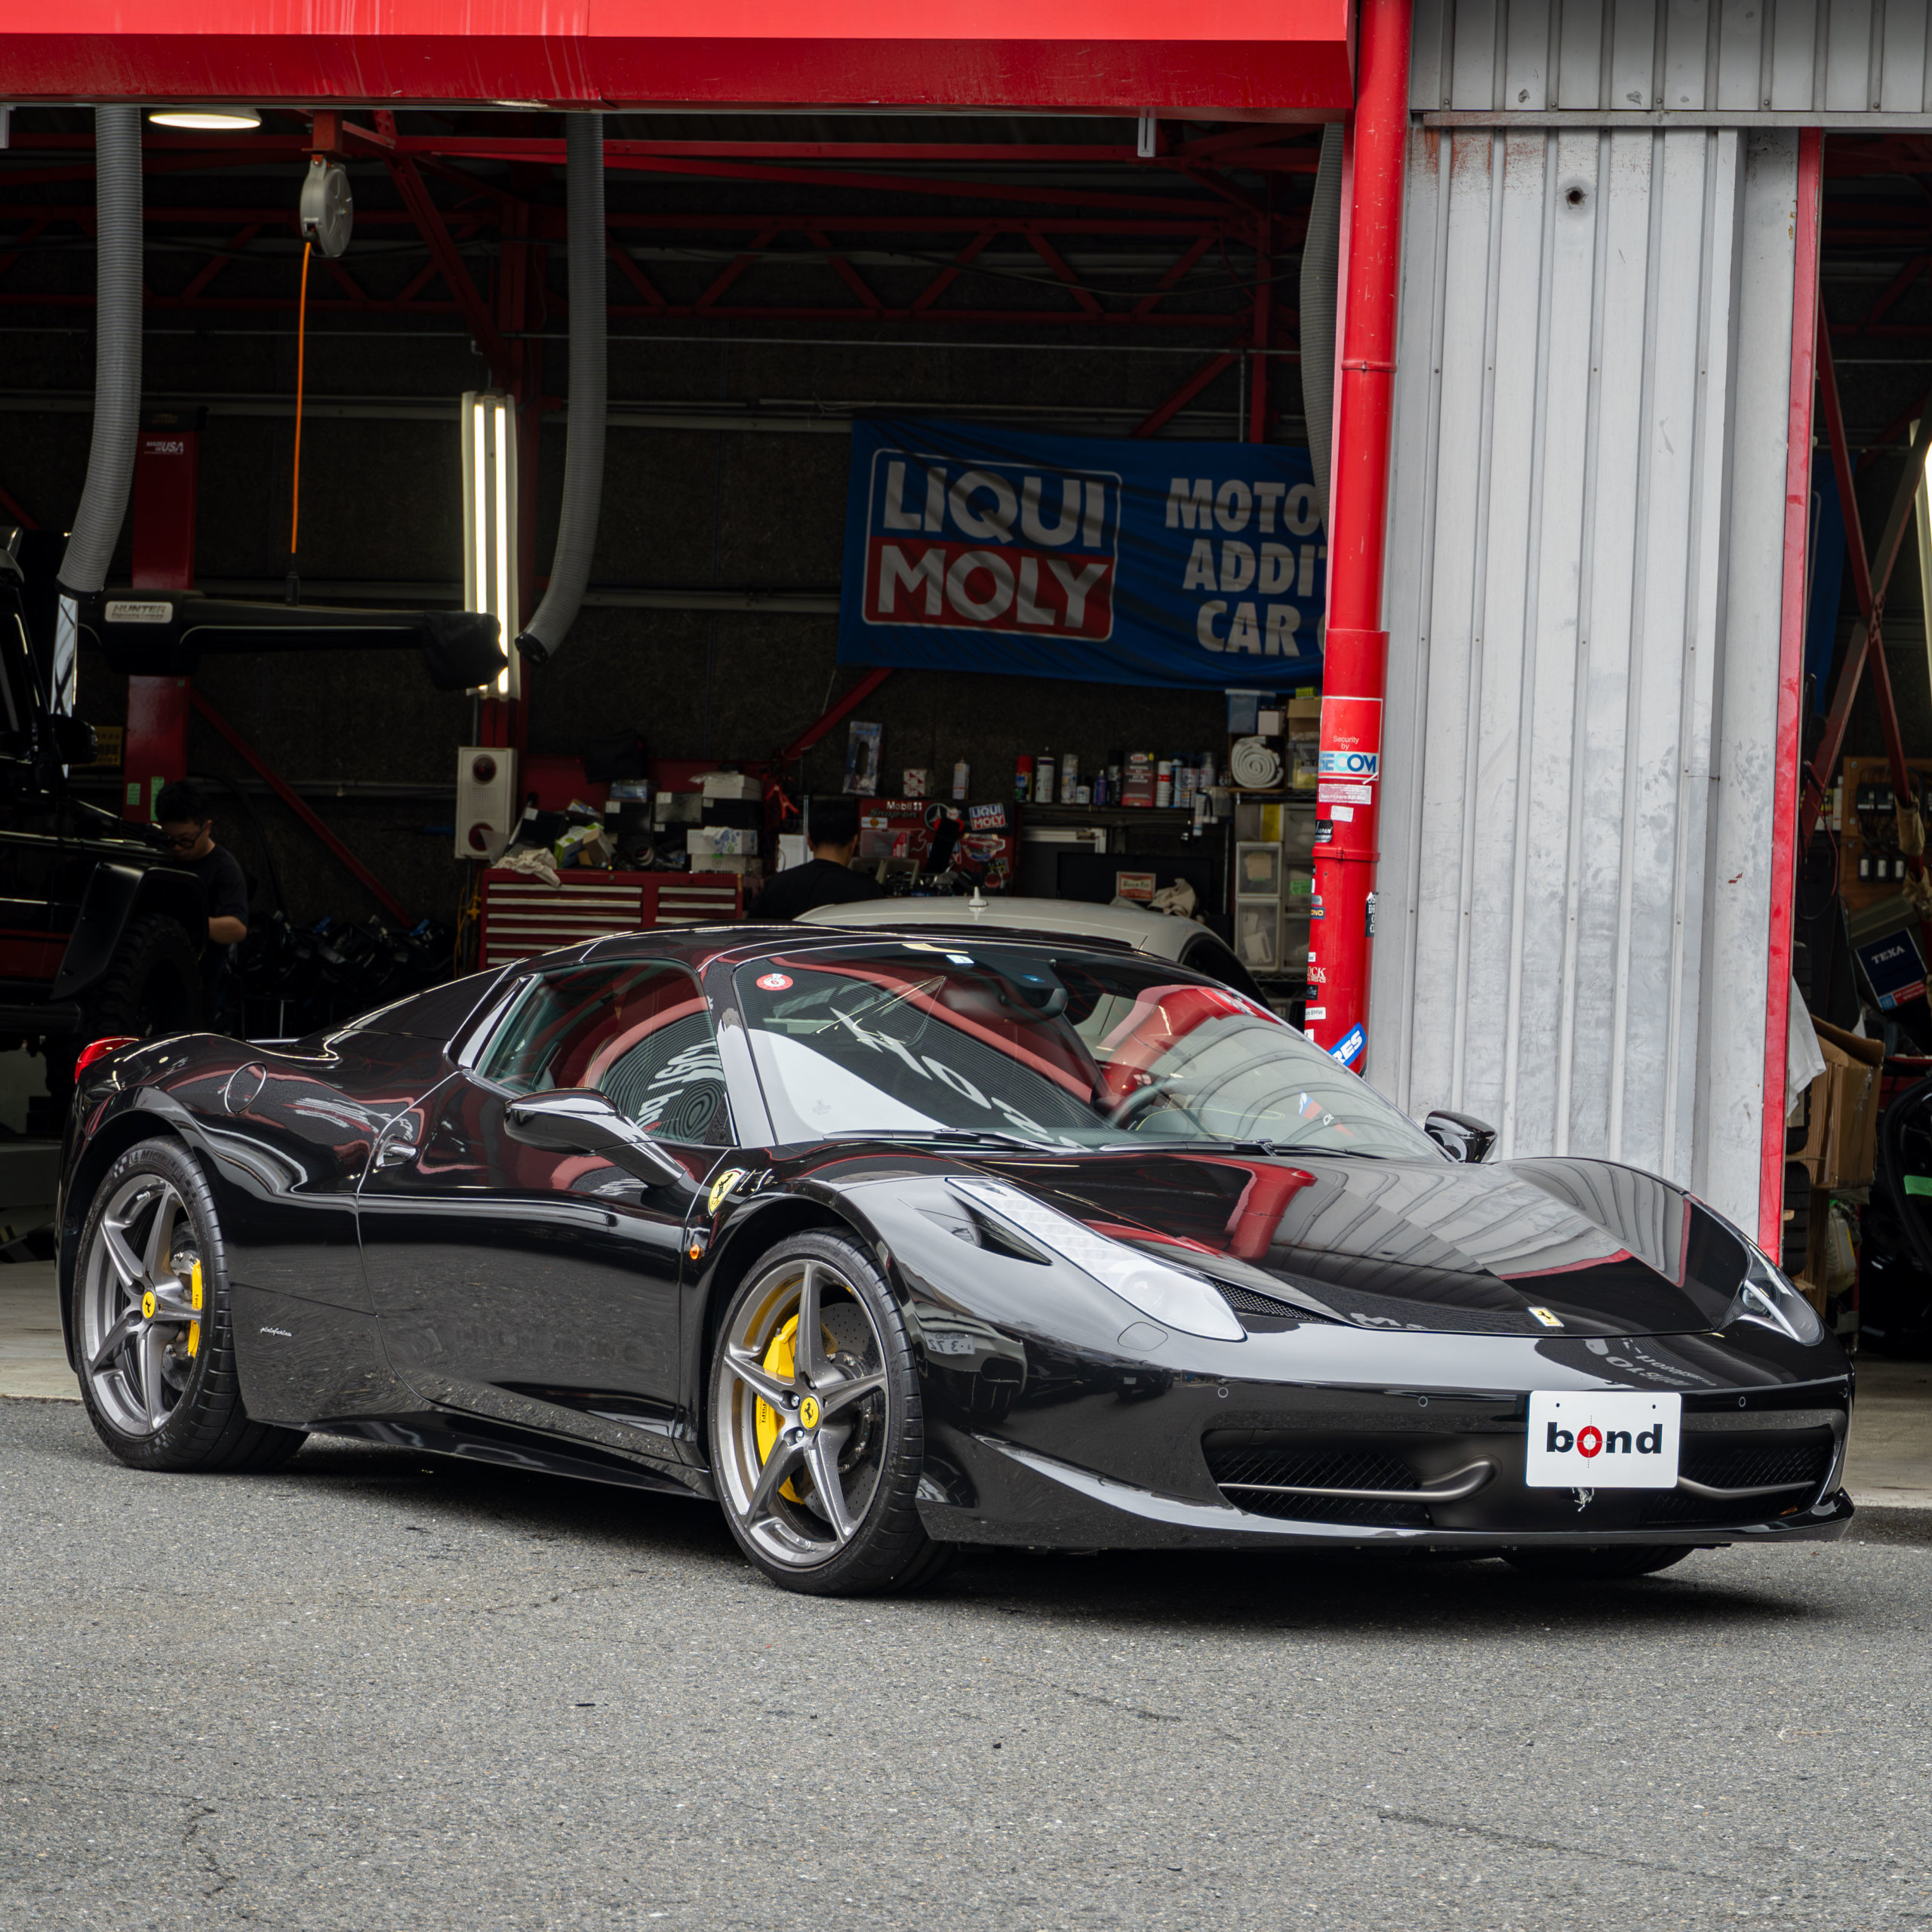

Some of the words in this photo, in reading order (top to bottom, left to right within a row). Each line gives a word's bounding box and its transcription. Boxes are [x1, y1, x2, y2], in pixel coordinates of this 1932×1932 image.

[162, 441, 184, 453] USA
[883, 460, 1105, 549] LIQUI
[878, 544, 1109, 629] MOLY
[112, 604, 167, 613] HUNTER
[1196, 599, 1301, 657] CAR
[1333, 735, 1360, 745] Security
[1319, 753, 1377, 773] SECOM
[886, 801, 912, 811] Mobil
[971, 804, 1002, 819] LIQUI
[974, 816, 1004, 829] MOLY
[1871, 945, 1906, 964] TEXA
[1546, 1421, 1663, 1458] bond
